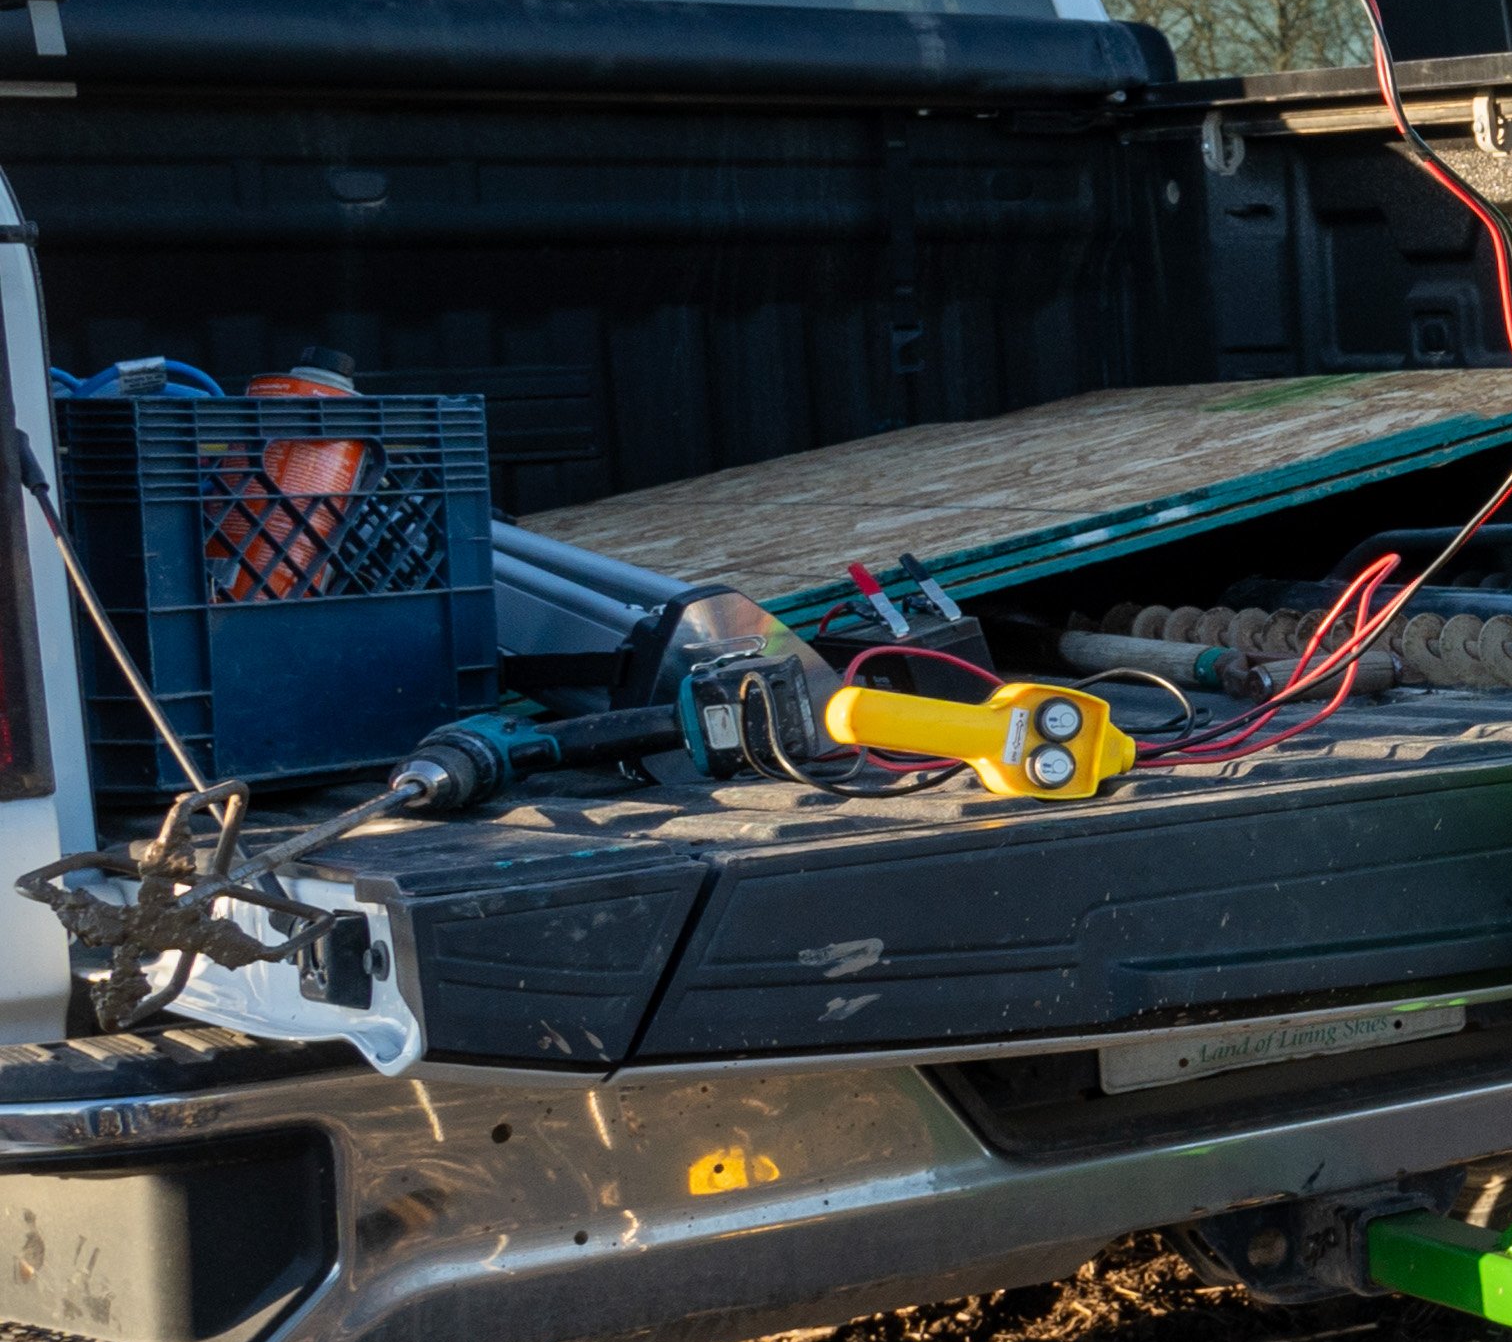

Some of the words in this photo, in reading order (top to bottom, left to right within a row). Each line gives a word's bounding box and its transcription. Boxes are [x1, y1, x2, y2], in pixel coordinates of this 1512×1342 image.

[1200, 1037, 1250, 1062] Land
[1253, 1030, 1277, 1056] of
[1278, 1024, 1337, 1049] Living
[1342, 1015, 1388, 1037] Skies
